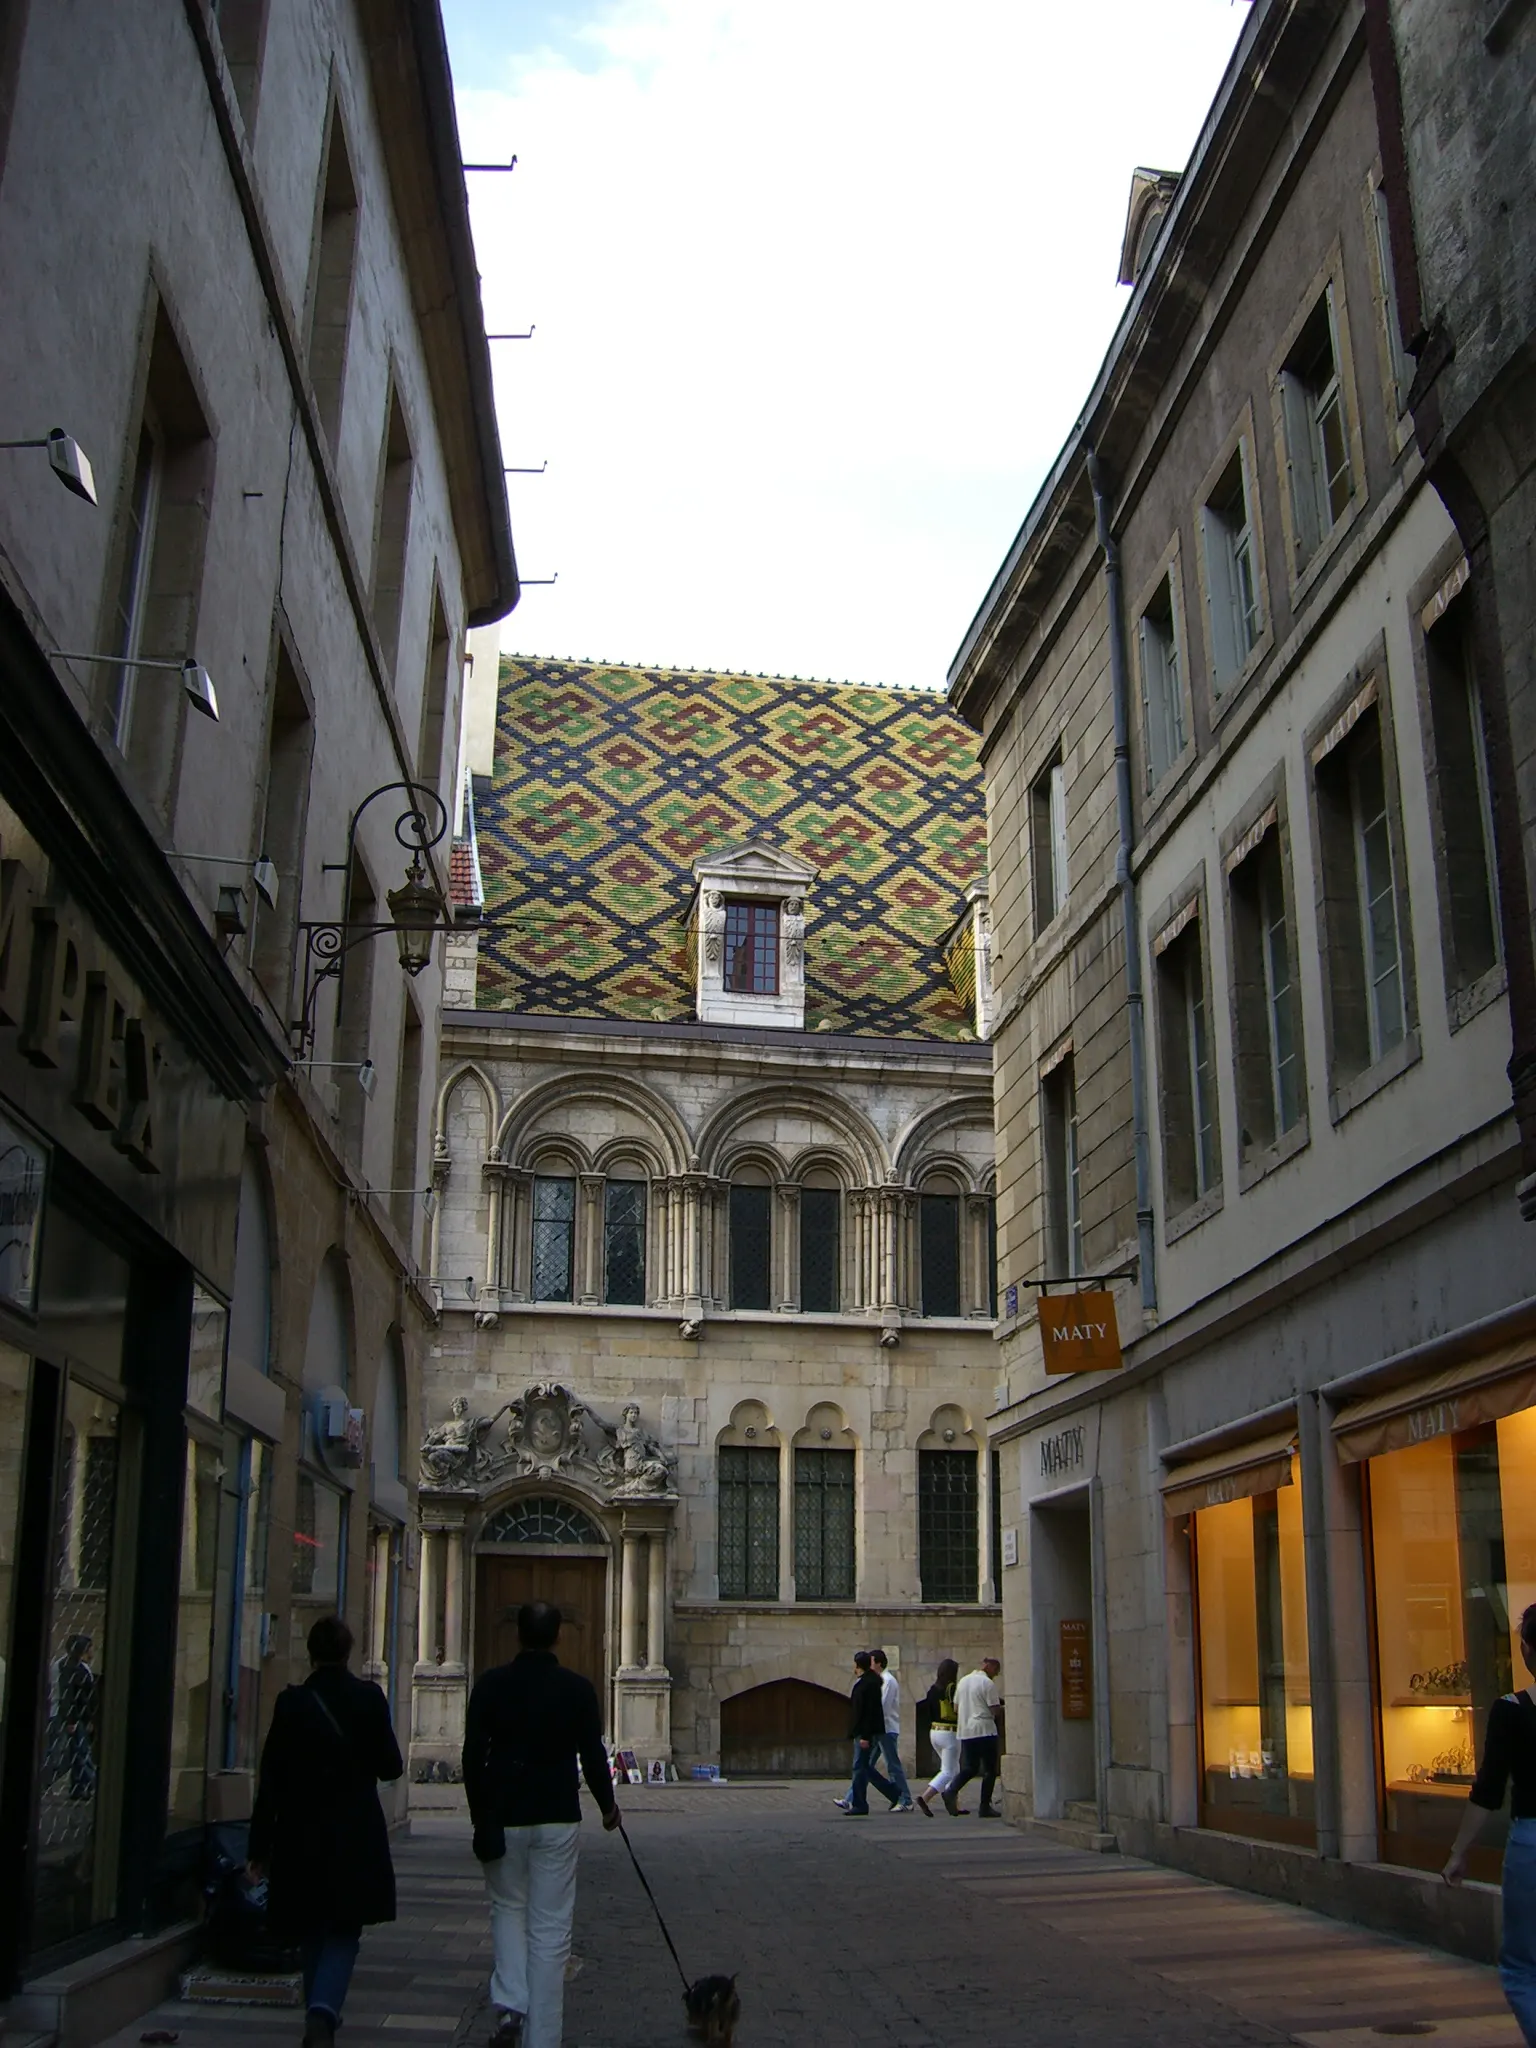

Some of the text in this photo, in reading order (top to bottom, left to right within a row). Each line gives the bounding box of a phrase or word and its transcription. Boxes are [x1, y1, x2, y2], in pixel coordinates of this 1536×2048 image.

[1052, 1322, 1107, 1343] MATY
[1405, 1398, 1460, 1443] MATY
[1040, 1425, 1086, 1477] MATY
[1062, 1623, 1086, 1632] MATY
